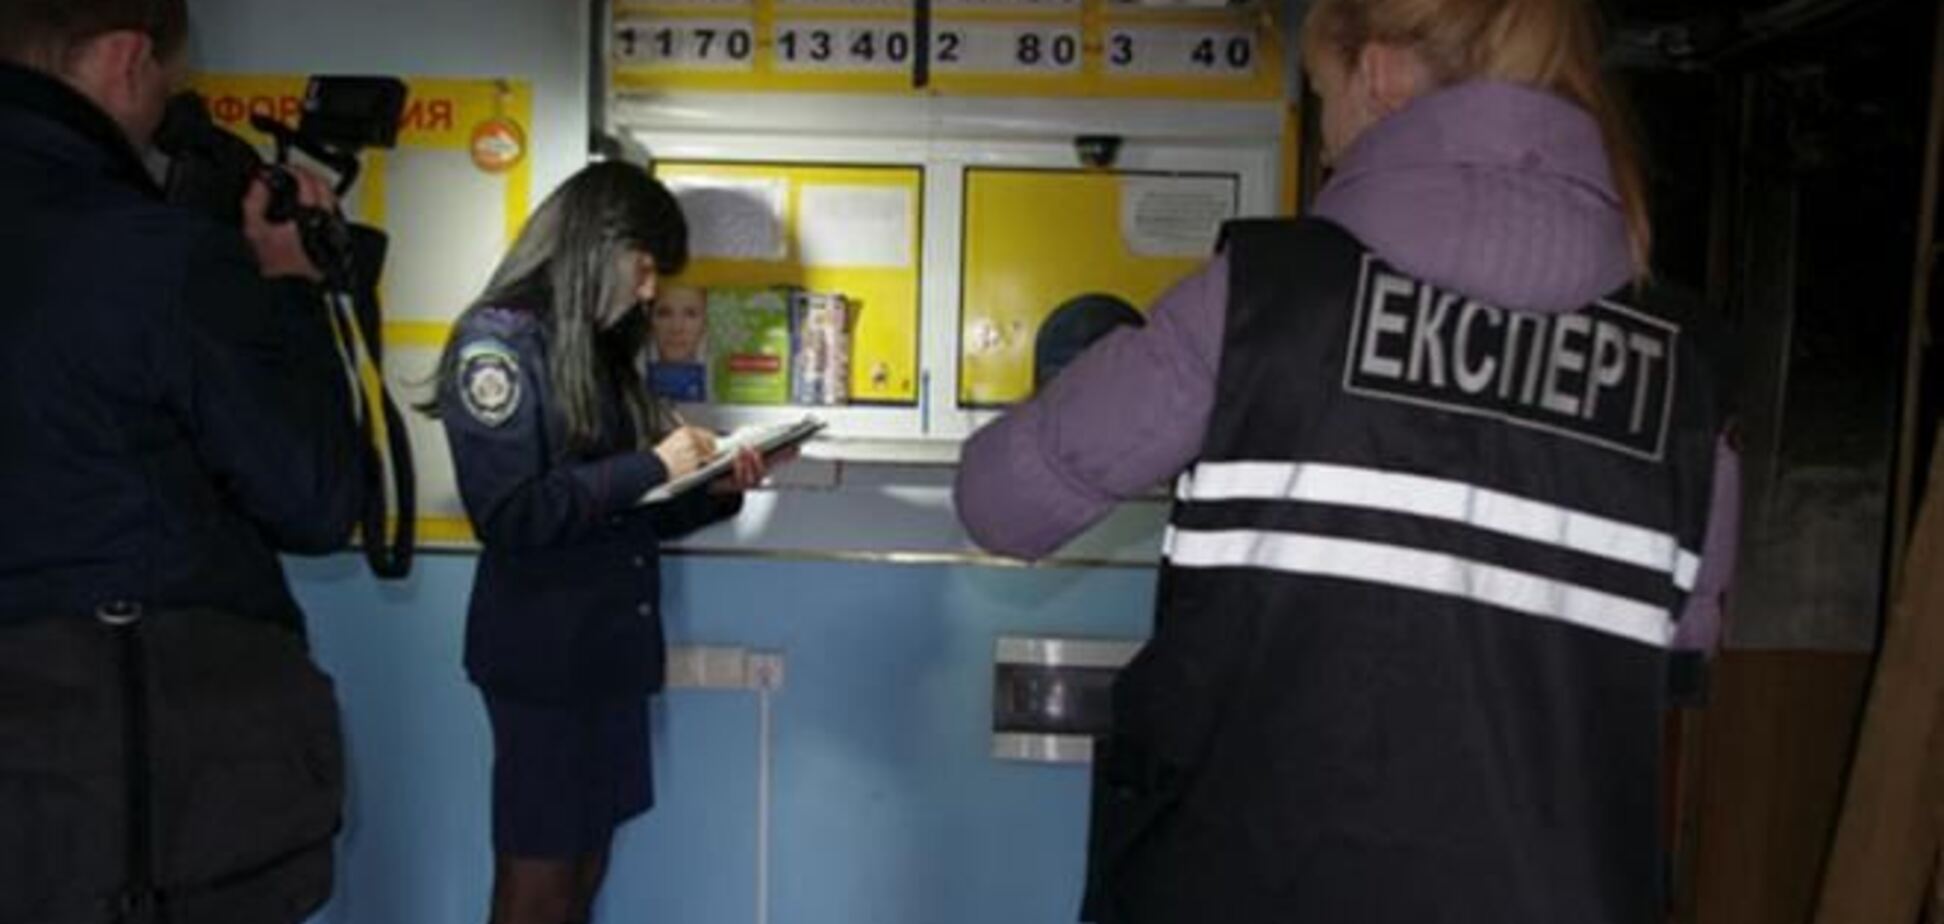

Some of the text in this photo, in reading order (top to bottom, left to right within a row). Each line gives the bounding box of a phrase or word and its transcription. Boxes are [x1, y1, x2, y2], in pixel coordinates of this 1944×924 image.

[1016, 32, 1076, 66] 80
[1190, 36, 1250, 69] 40
[1360, 272, 1664, 434] ЕКСПЕРТ
